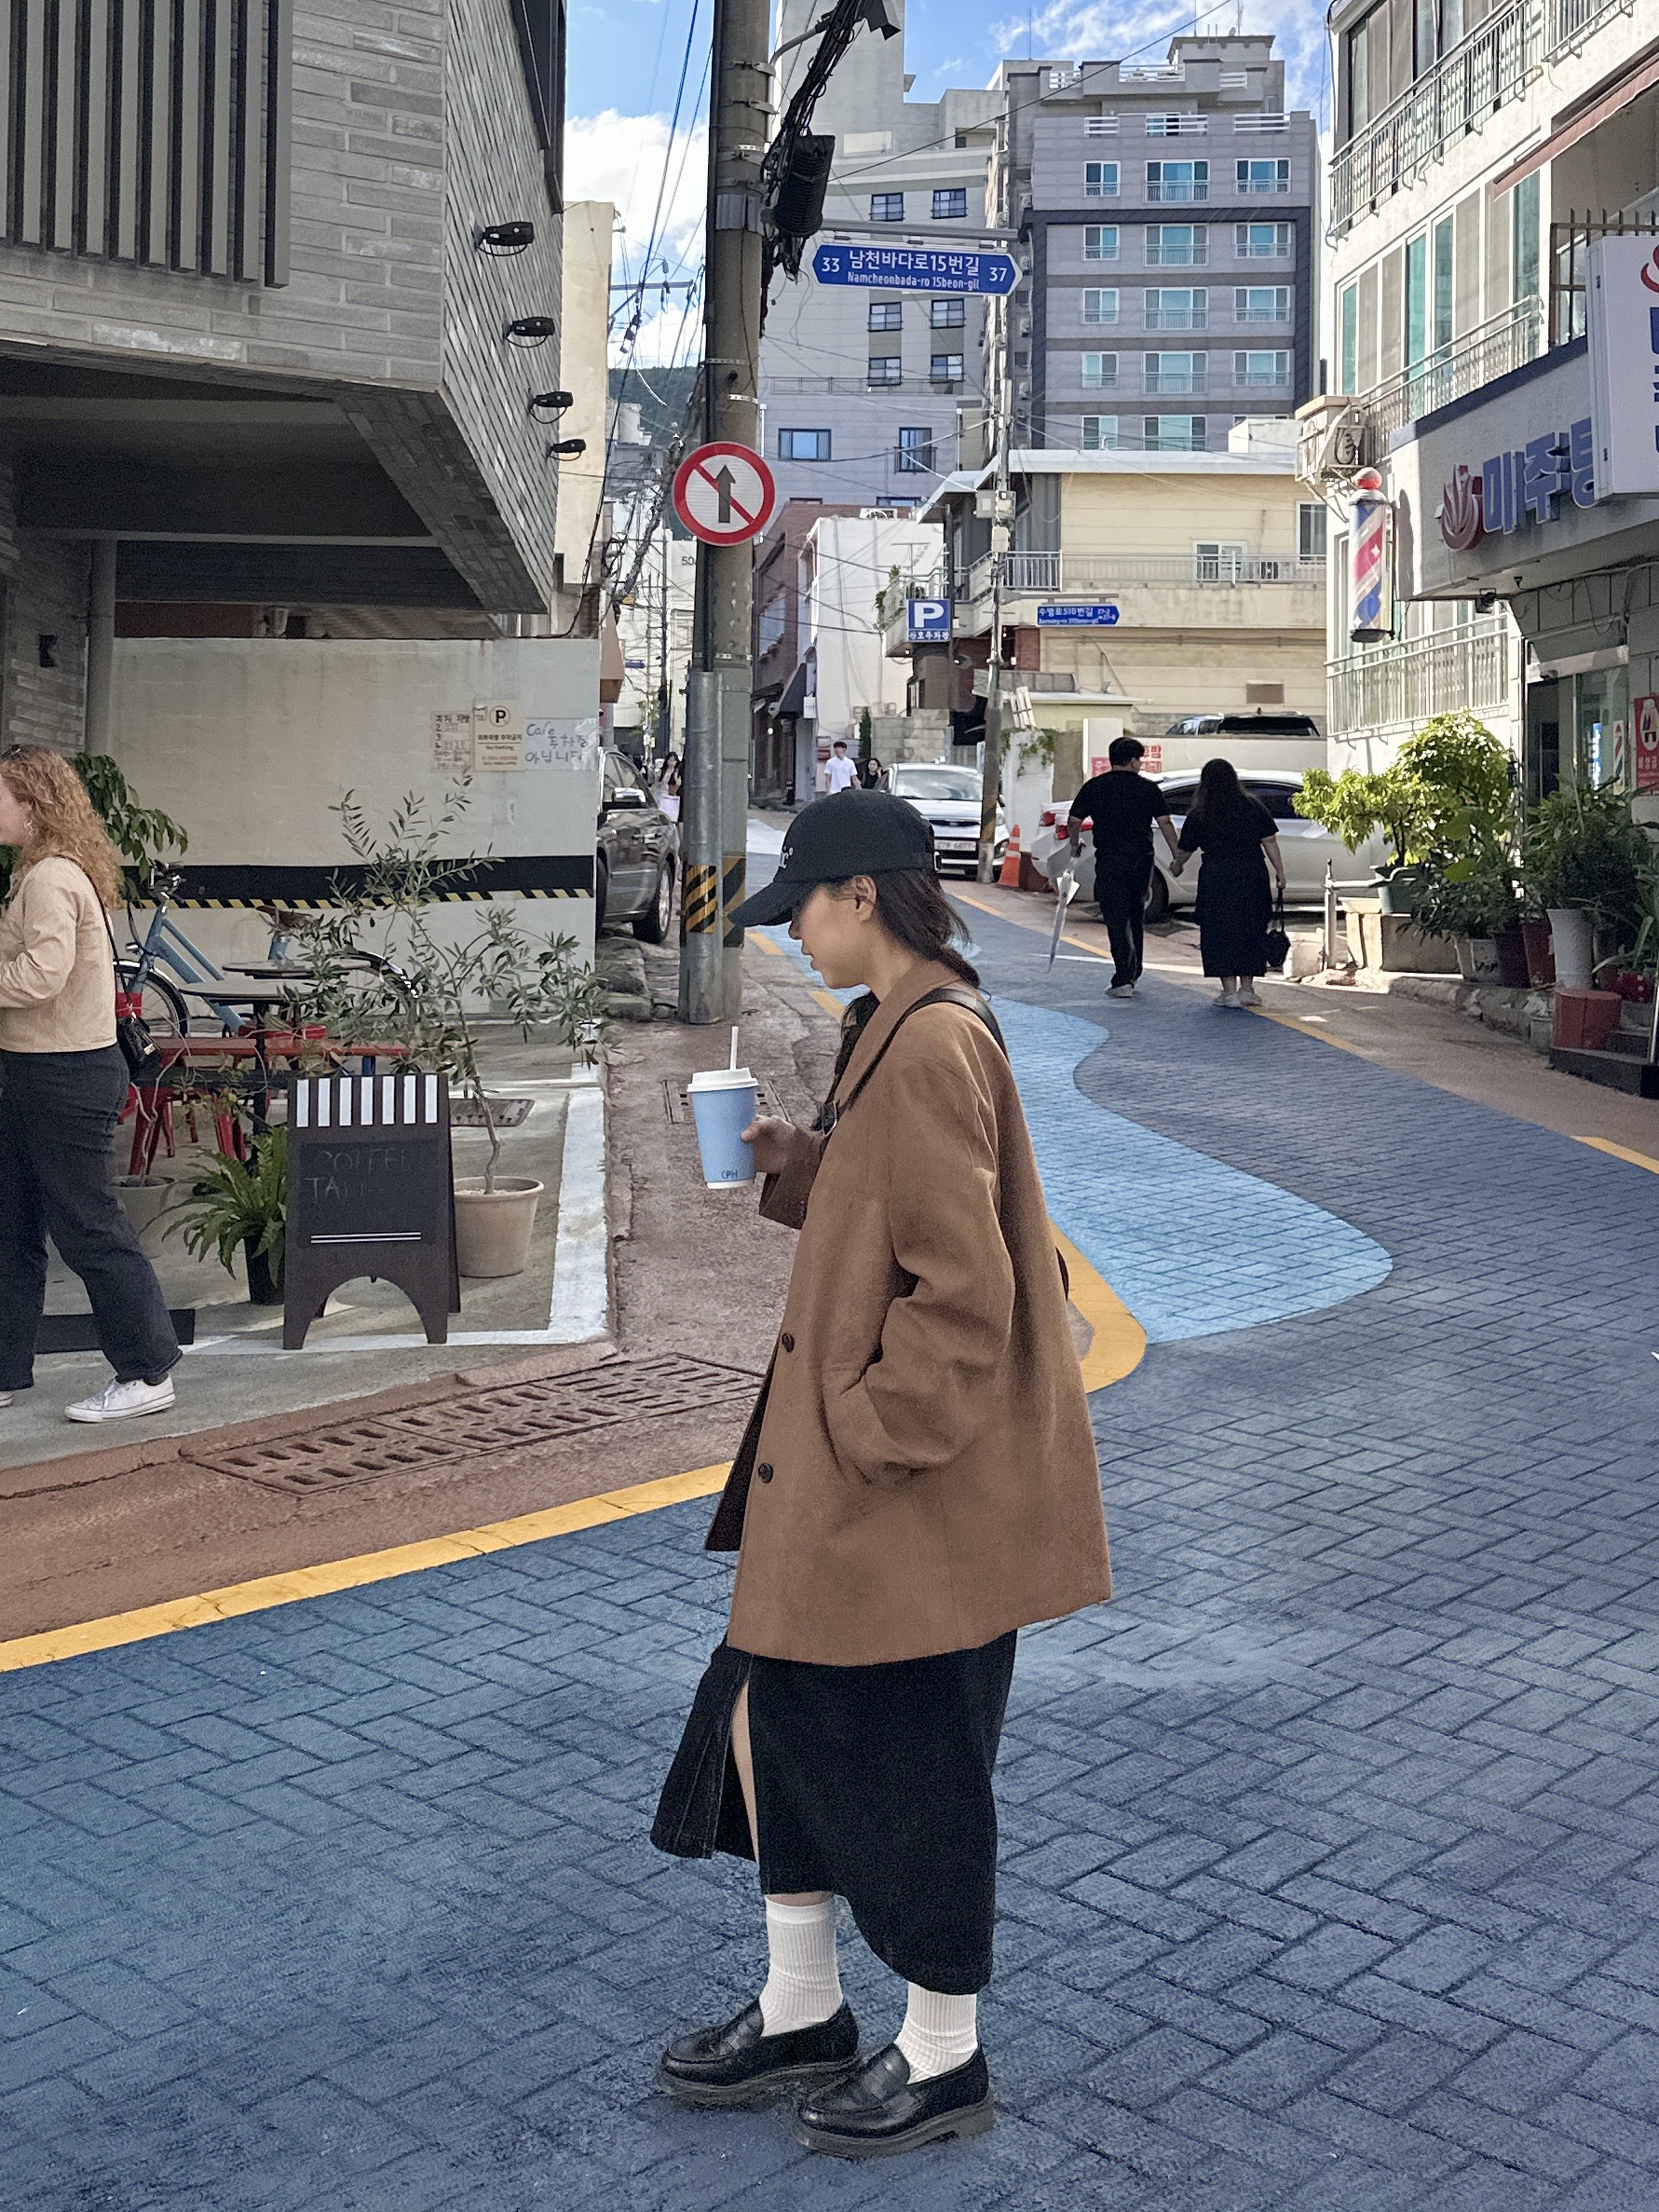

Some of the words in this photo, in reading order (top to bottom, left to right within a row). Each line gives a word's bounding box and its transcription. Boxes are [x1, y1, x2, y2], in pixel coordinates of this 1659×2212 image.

[822, 257, 840, 273] 33
[849, 250, 979, 277] 남천바다로15번길
[848, 271, 930, 287] Namcheonbada-ro
[932, 278, 980, 292] 15beon-gil
[988, 266, 1008, 282] 37
[914, 602, 945, 628] P
[496, 709, 507, 724] P
[526, 721, 554, 736] Cafe
